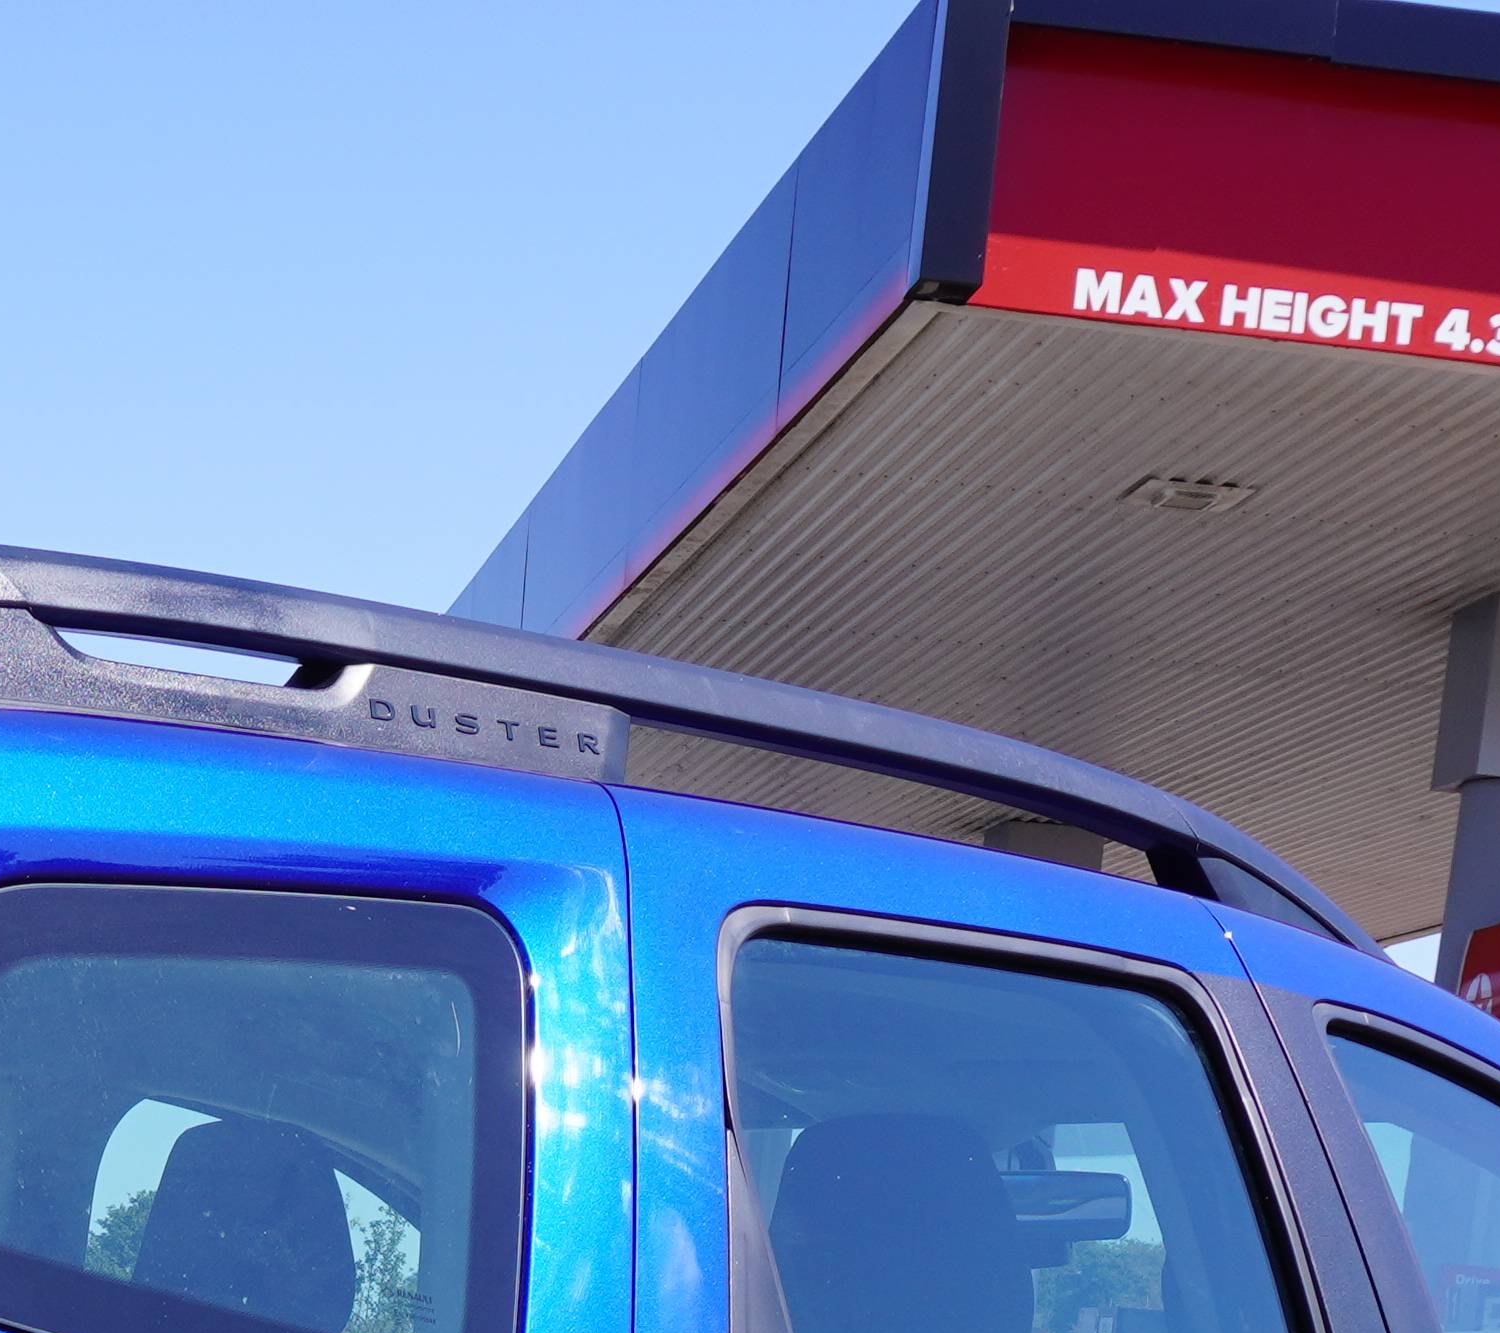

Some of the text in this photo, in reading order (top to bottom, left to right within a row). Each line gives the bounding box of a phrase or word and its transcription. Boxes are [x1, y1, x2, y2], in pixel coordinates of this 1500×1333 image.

[1073, 267, 1208, 323] MAX
[1219, 284, 1424, 345] HEIGHT
[368, 697, 601, 757] DUSTER
